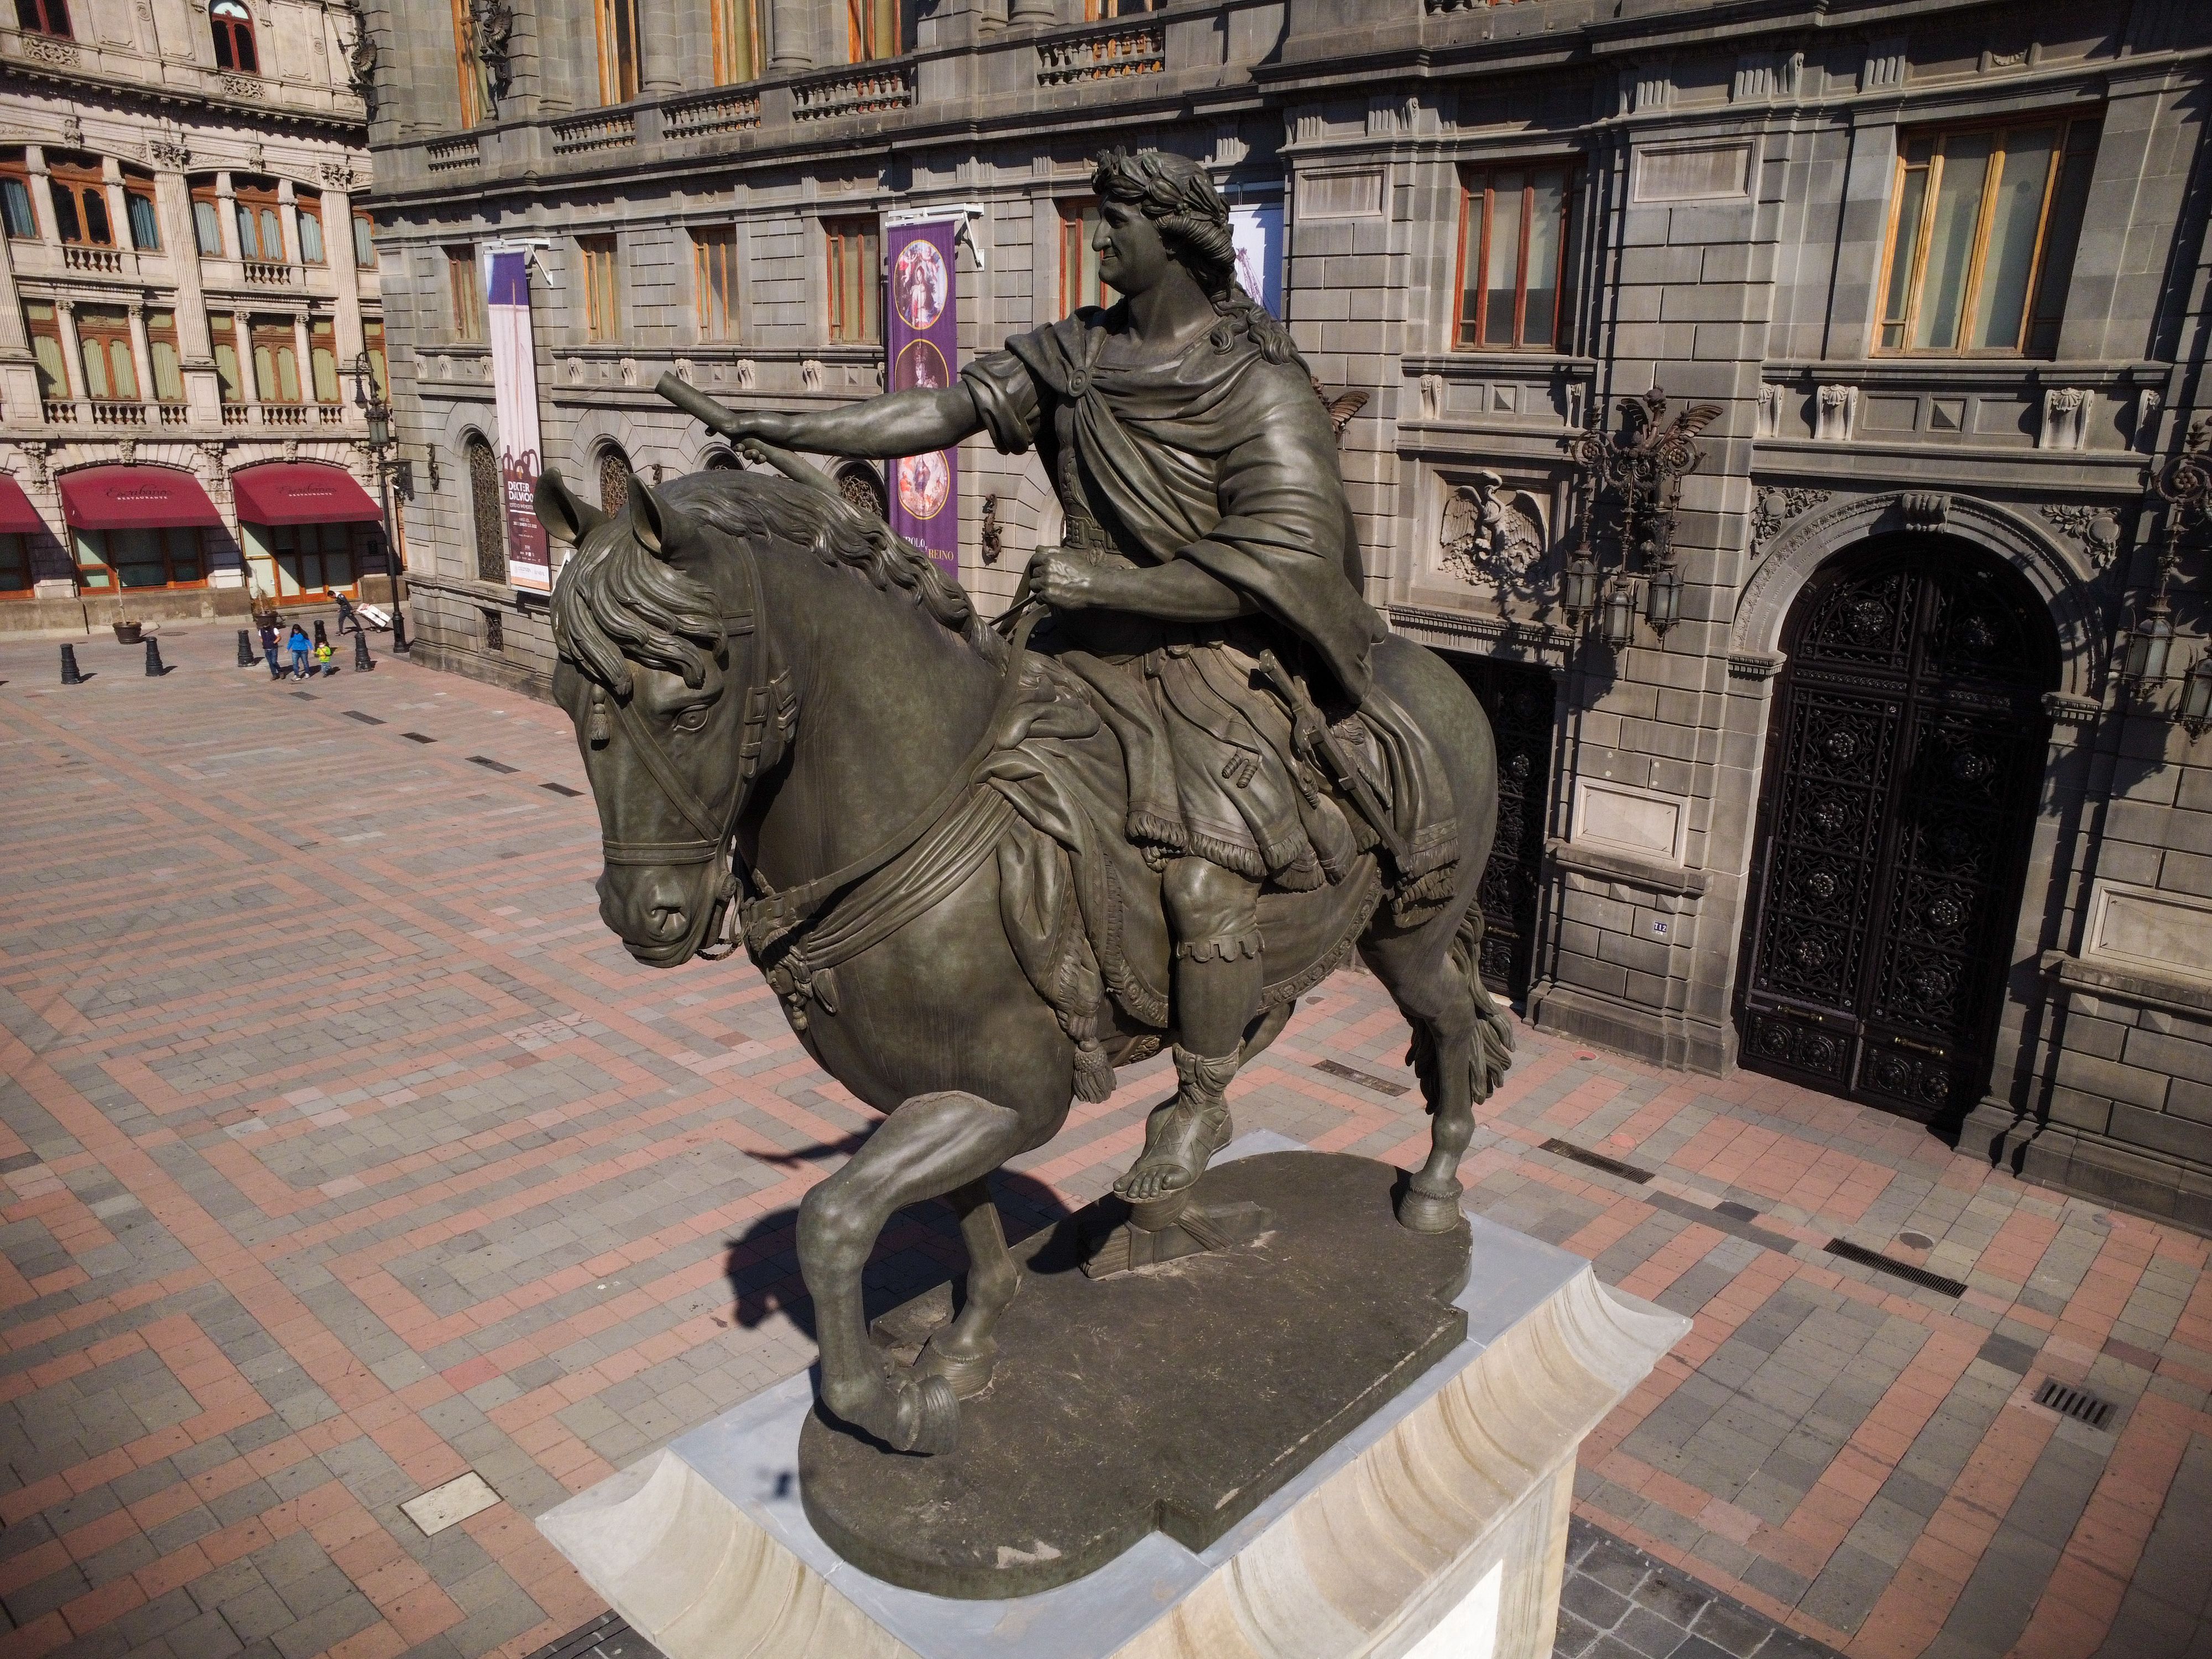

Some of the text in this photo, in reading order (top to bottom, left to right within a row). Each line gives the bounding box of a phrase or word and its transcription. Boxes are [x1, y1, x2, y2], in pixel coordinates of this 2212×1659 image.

[508, 481, 530, 493] DEXTER
[509, 491, 534, 503] DALWOO
[928, 549, 954, 561] REINO
